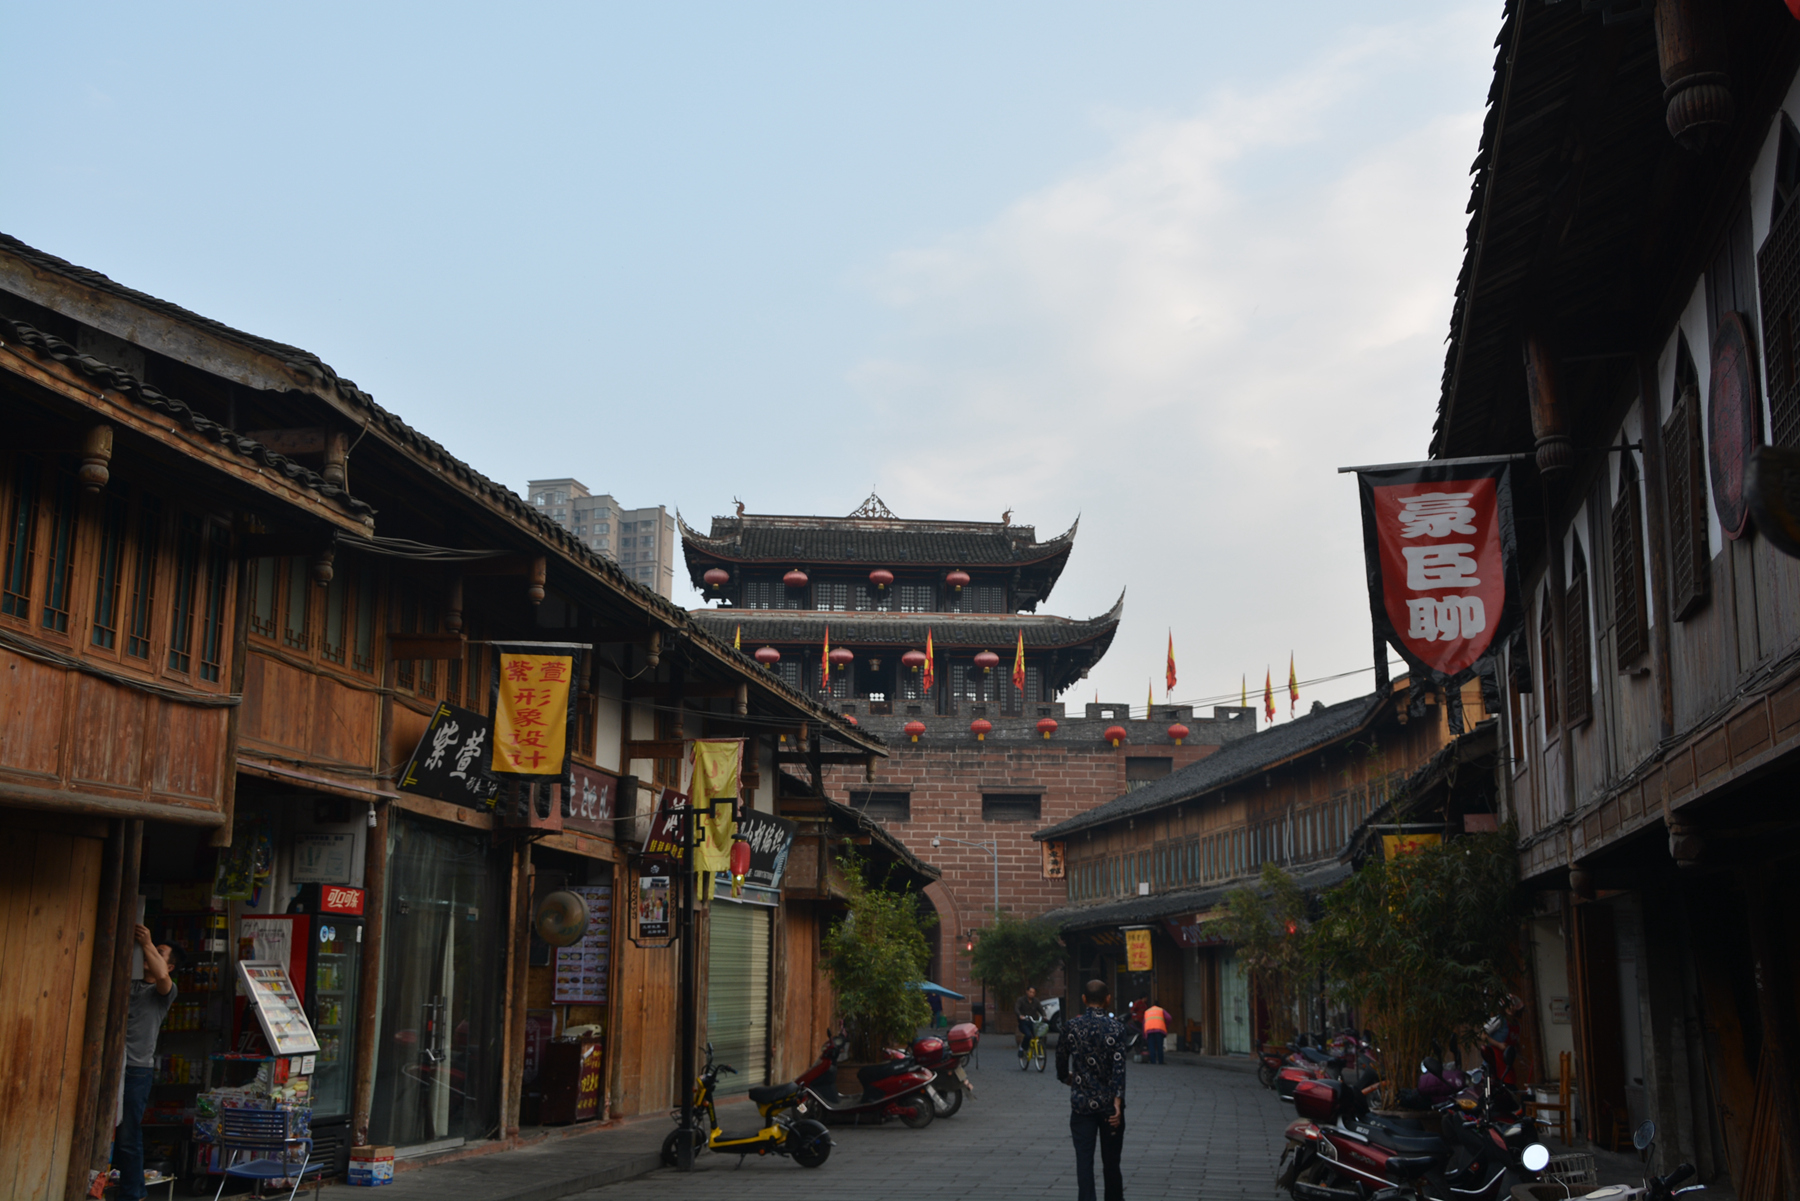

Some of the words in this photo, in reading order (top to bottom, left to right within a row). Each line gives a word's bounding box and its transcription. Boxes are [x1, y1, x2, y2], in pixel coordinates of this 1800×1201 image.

[1397, 492, 1486, 642] 豪臣聊
[505, 660, 567, 683] 紫萱
[424, 720, 487, 780] 紫萱
[508, 688, 549, 769] 形象设计
